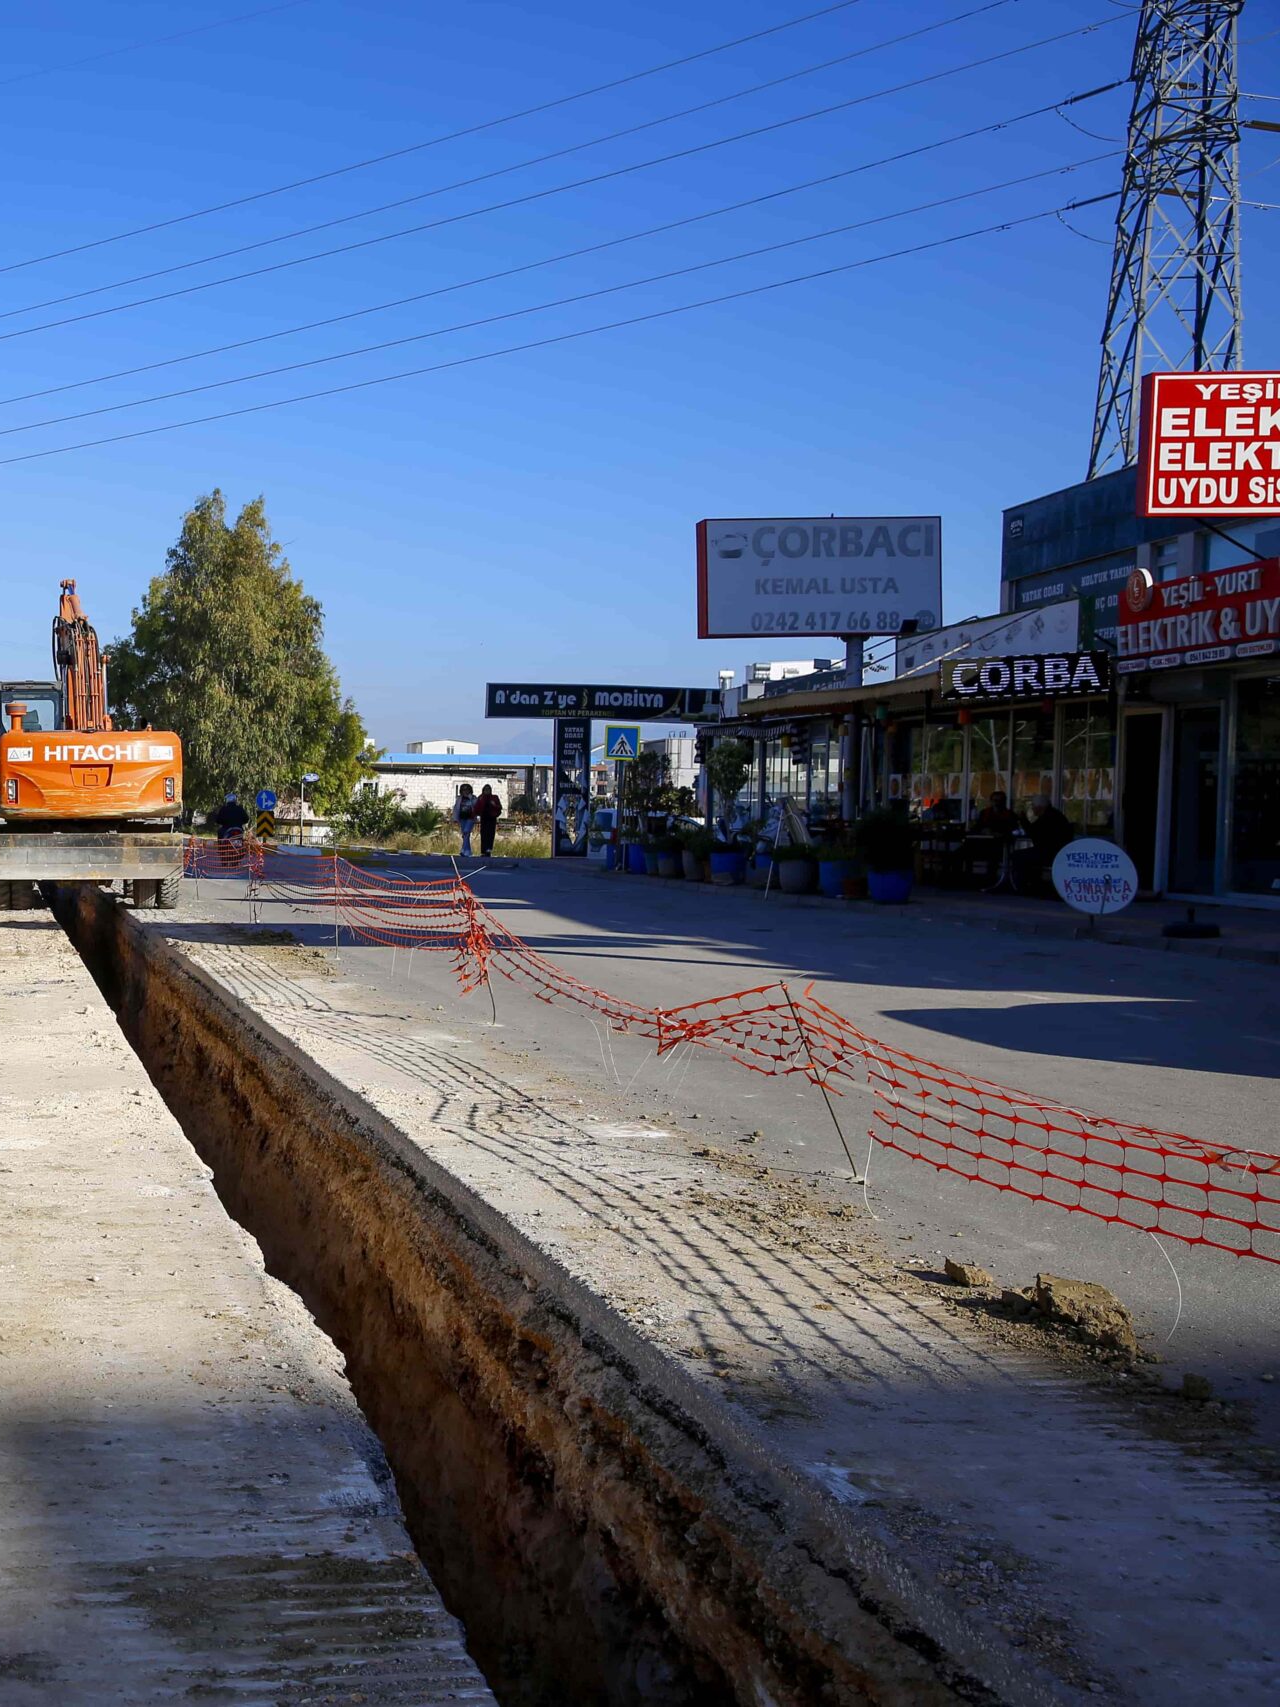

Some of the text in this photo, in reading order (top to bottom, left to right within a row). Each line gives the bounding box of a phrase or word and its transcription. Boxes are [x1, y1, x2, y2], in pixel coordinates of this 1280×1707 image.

[1195, 379, 1280, 404] YEŞİ
[1157, 477, 1239, 505] UYDU
[751, 524, 934, 566] ÇORBACI
[754, 577, 899, 595] KEMAL USTA
[751, 611, 800, 631] 0242
[805, 611, 841, 631] 417
[847, 611, 870, 630] 66
[876, 611, 900, 630] 88
[1219, 607, 1242, 640] &
[495, 688, 664, 708] A'dan Z'ye MOBİLYA
[44, 744, 139, 762] HITACHI
